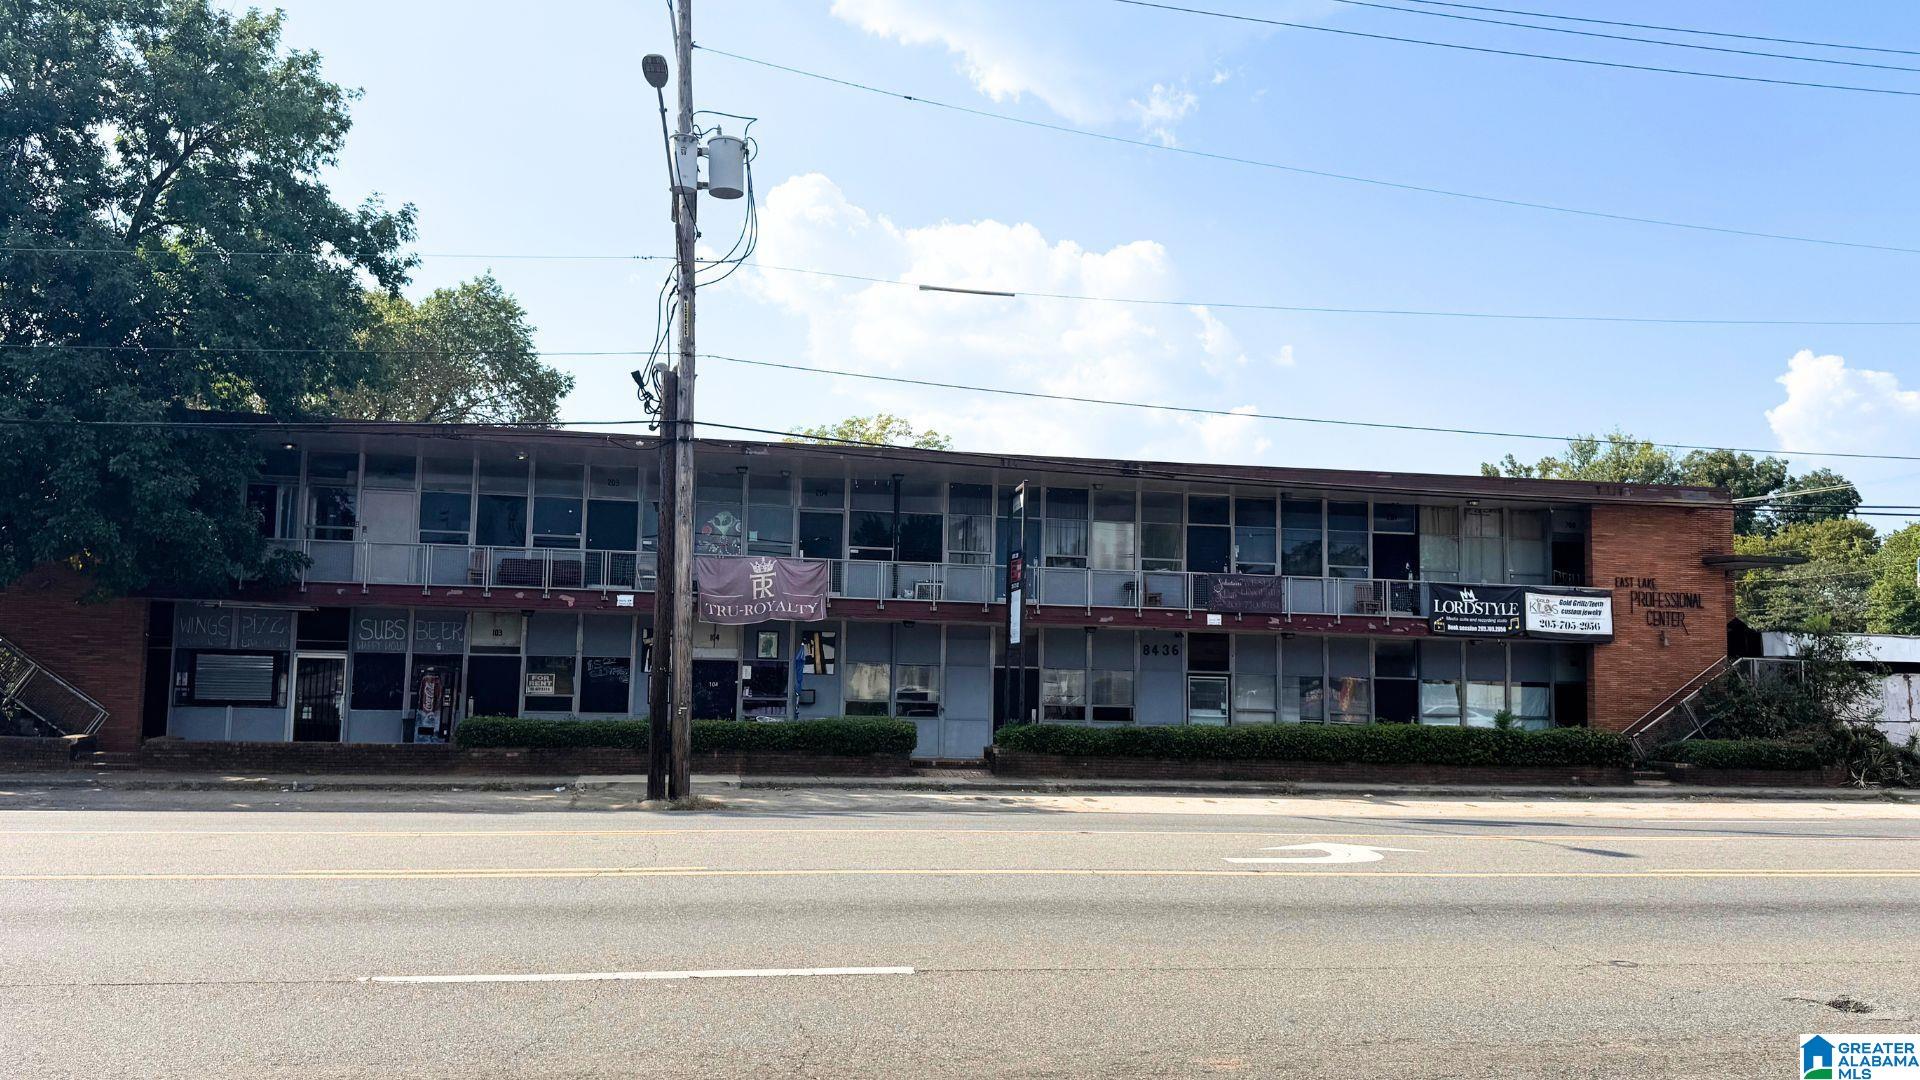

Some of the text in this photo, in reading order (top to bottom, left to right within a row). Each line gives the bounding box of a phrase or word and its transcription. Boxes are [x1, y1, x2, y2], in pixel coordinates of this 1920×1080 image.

[1614, 577, 1656, 589] EAST LAKE
[705, 600, 819, 617] TRU-ROYALTY
[1433, 599, 1520, 616] LORDSTYLE
[1630, 590, 1704, 614] PROFESSIONAL
[179, 615, 231, 637] WINGS
[358, 618, 464, 642] SUBS BEER
[1539, 619, 1601, 631] 205-705-2956
[1646, 610, 1690, 636] CENTER
[1143, 644, 1179, 656] 8436
